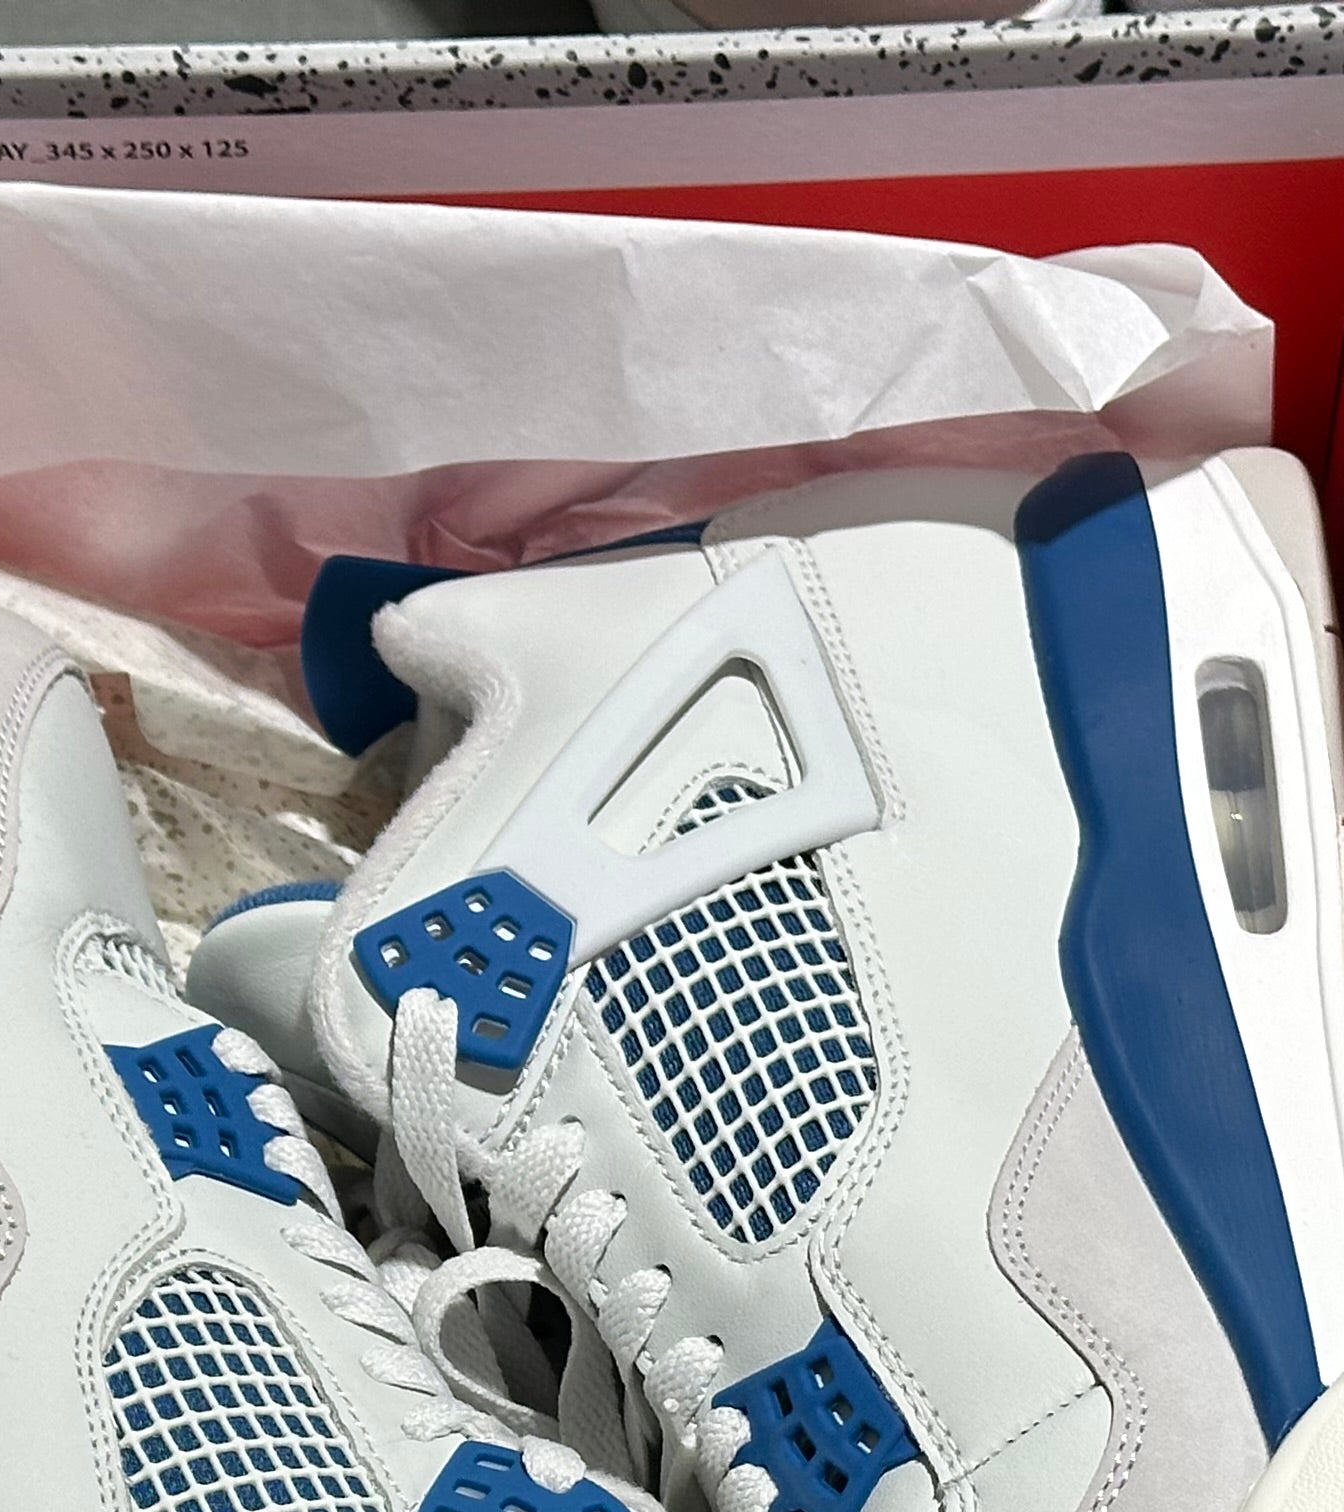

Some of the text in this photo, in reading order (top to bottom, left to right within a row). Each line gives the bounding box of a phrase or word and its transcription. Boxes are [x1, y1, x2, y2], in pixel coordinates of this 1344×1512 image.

[101, 145, 116, 160] x
[123, 141, 172, 160] 250
[178, 144, 194, 159] x
[202, 140, 249, 158] 125
